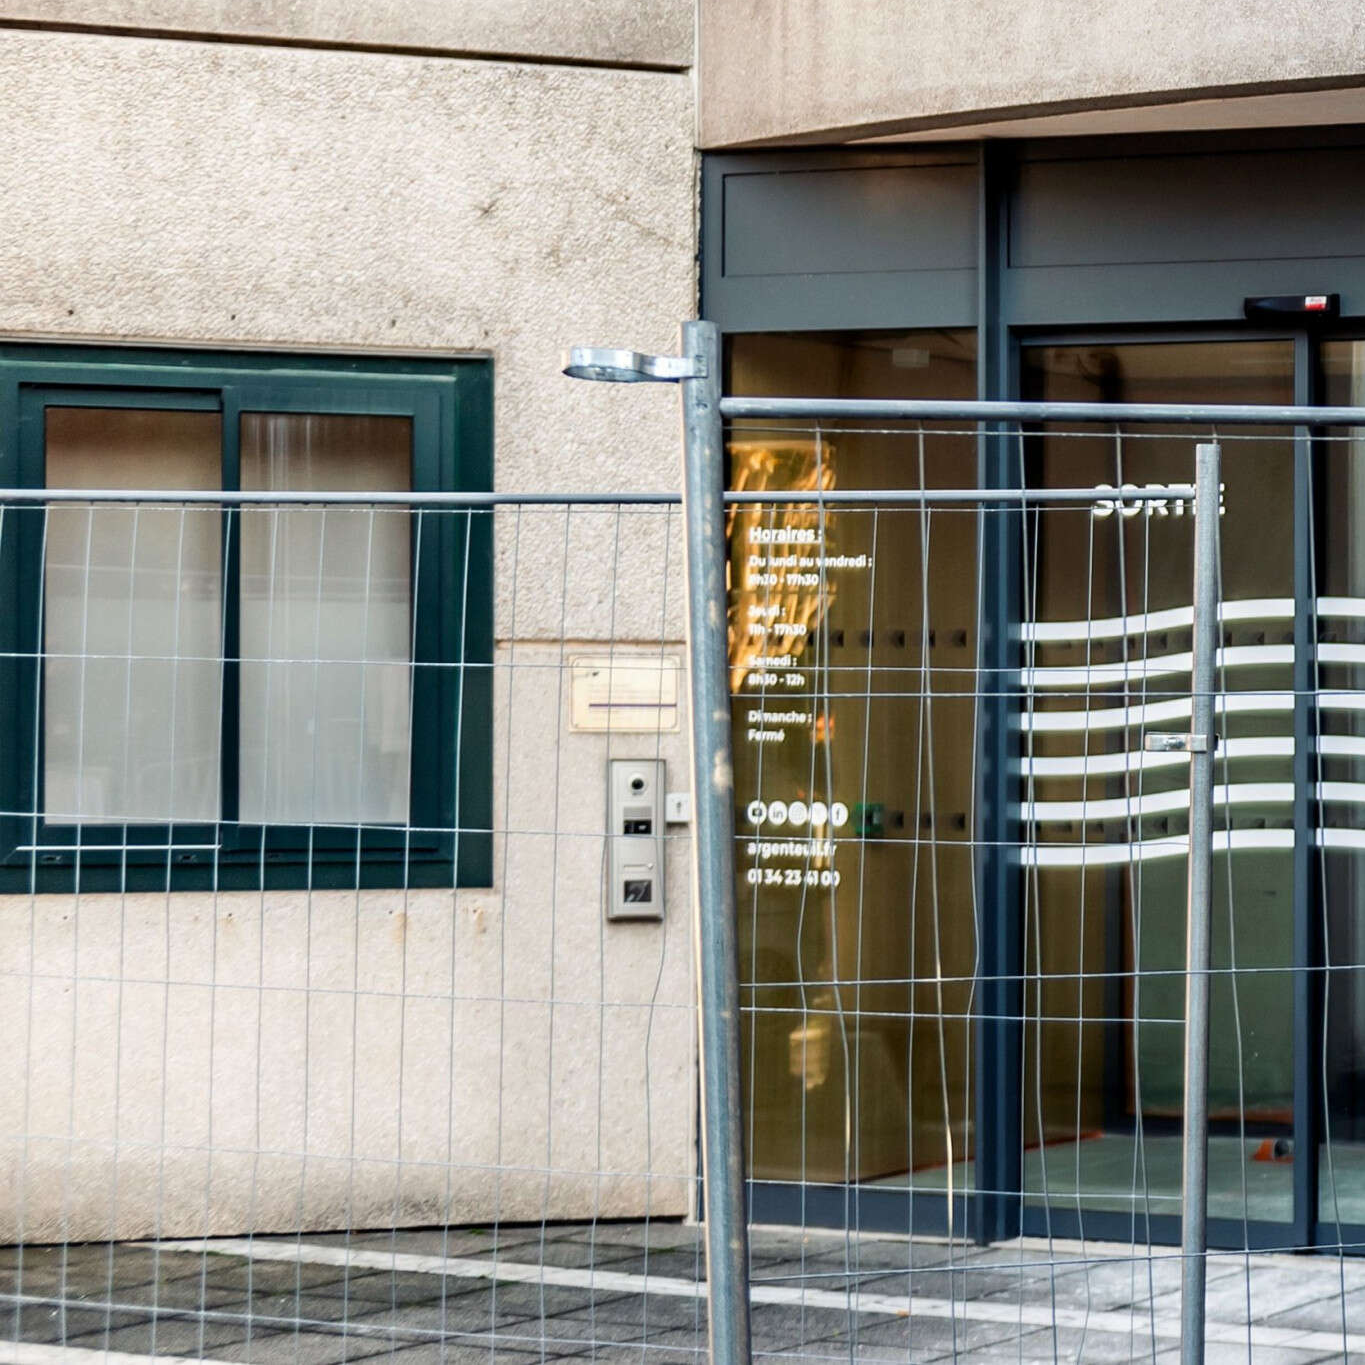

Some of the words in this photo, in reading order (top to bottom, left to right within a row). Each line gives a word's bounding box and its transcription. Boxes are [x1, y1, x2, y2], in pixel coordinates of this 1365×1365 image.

[749, 525, 816, 543] Horaires
[748, 710, 806, 723] Dimanche
[748, 728, 785, 742] Fermé
[747, 839, 837, 859] argenteuil.fr
[747, 868, 763, 884] 01
[764, 869, 783, 885] 34
[784, 869, 802, 885] 23
